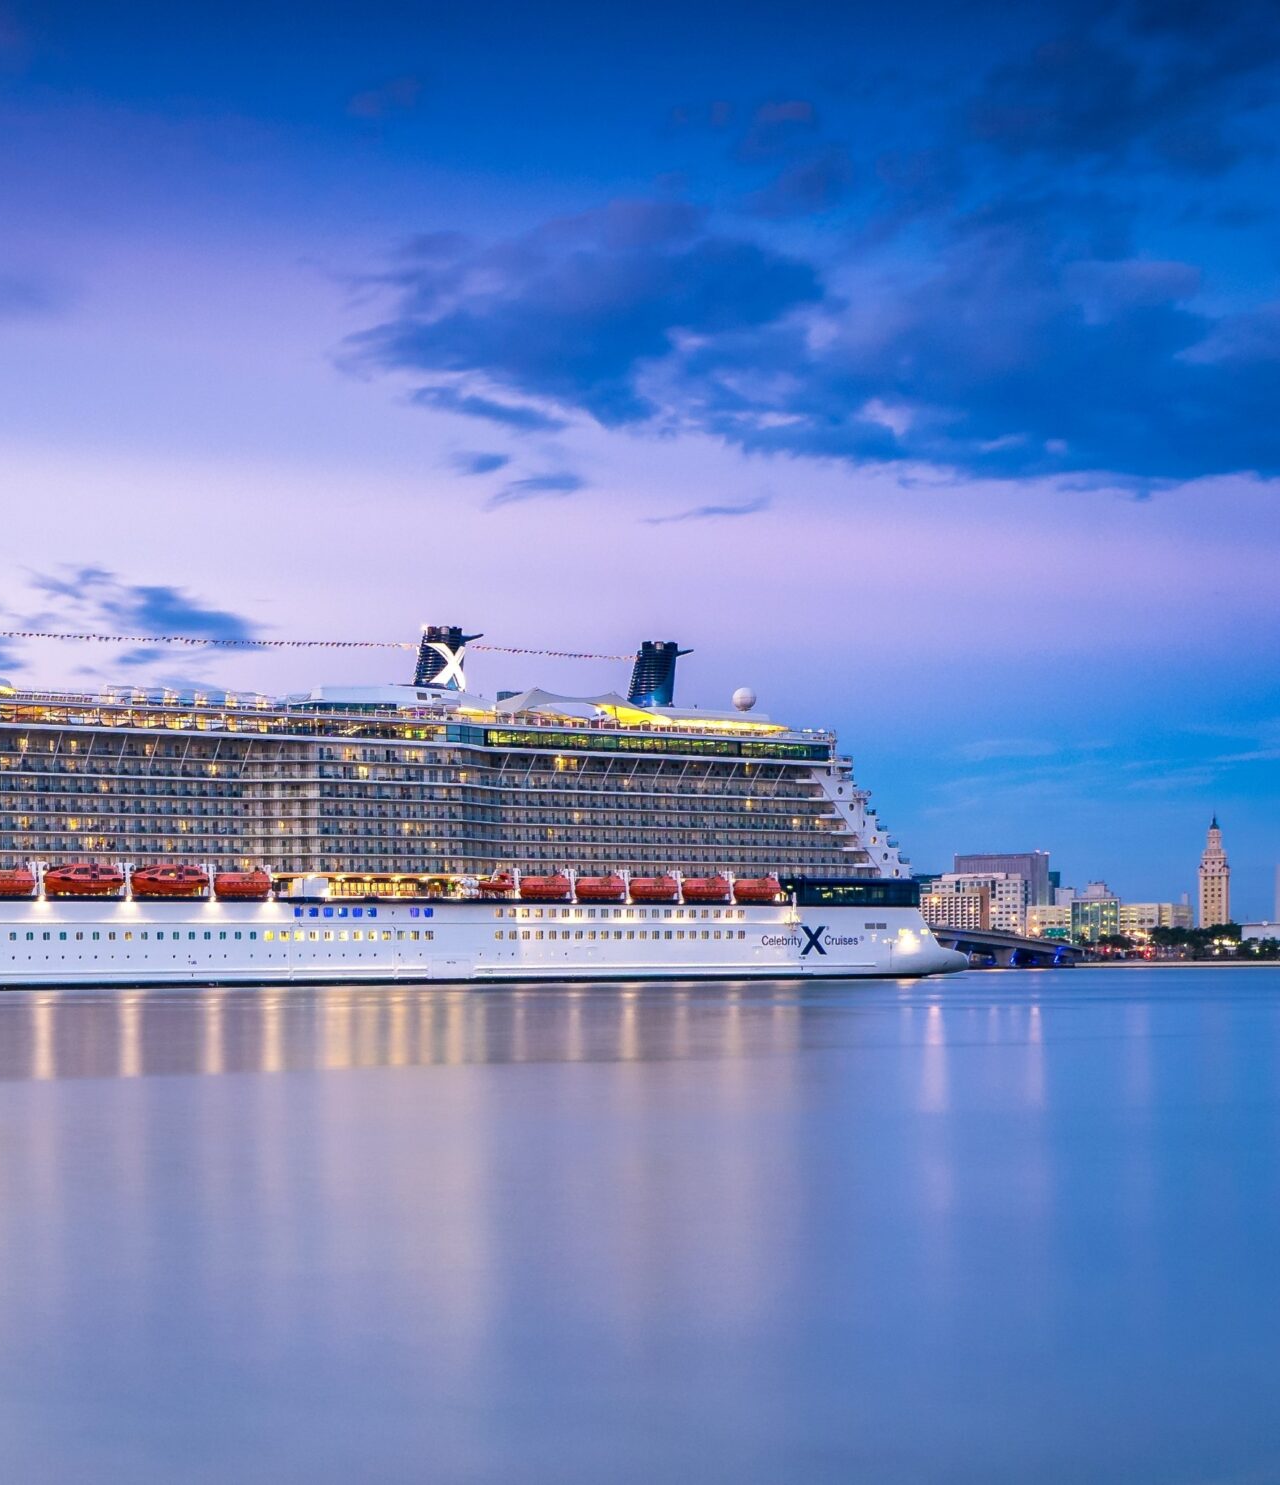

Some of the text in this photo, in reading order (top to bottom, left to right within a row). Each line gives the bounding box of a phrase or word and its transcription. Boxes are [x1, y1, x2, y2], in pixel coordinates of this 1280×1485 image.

[761, 925, 859, 955] Celebrity X Cruises
